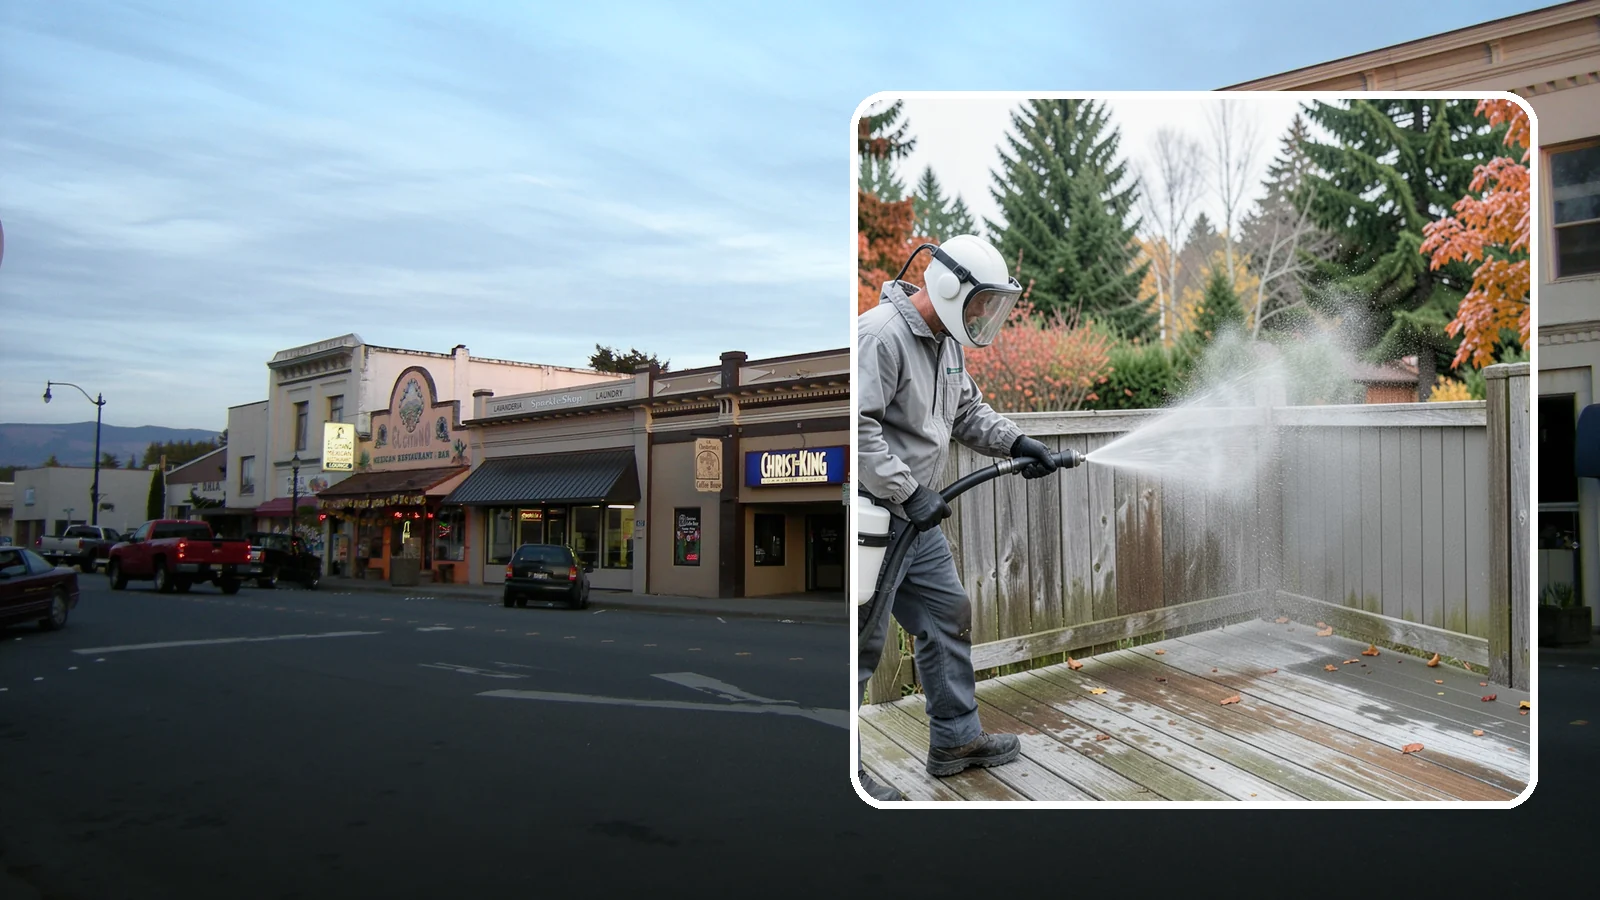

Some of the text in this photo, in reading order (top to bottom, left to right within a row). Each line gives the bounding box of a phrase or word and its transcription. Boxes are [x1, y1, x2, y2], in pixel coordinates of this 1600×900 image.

[595, 388, 624, 400] LAUNDRY
[493, 402, 523, 413] LAVANDERIA
[530, 394, 583, 409] Sparkle Shop
[373, 450, 450, 464] MEXICAN RESTAURANT BAR
[761, 449, 828, 478] CHRIST KING
[697, 481, 709, 489] Coffee
